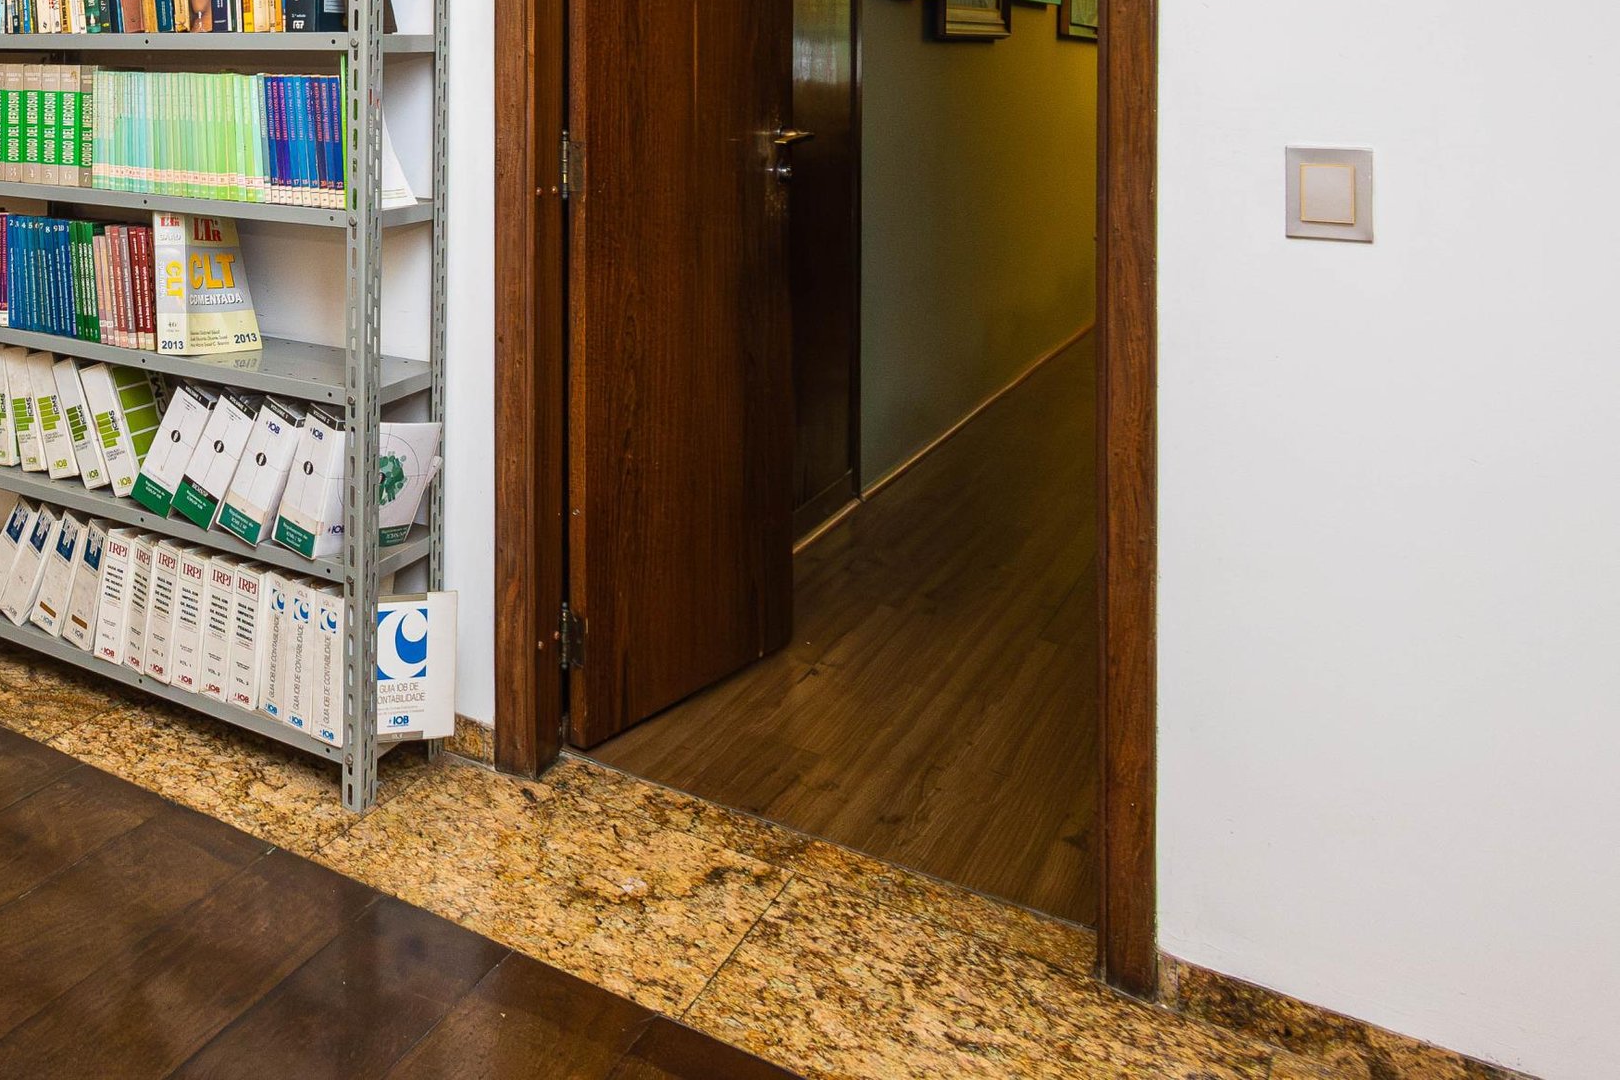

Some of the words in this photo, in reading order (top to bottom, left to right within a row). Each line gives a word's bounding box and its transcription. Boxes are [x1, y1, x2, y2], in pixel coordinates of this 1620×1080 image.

[8, 92, 19, 124] MERCOSUR
[27, 91, 38, 124] MERCOSUR
[44, 92, 55, 125] MERCOSUR
[63, 93, 74, 126] MERCOSUR
[82, 94, 92, 128] MERCOSUR
[8, 125, 19, 137] DEL
[27, 125, 38, 137] DEL
[44, 126, 55, 138] DEL
[63, 127, 74, 139] DEL
[82, 129, 92, 141] DEL
[46, 168, 53, 179] 5
[83, 172, 90, 182] 7
[188, 252, 236, 289] CLT
[166, 261, 184, 299] CLT
[189, 292, 244, 306] COMENTADA
[161, 340, 184, 350] 2013
[233, 333, 258, 344] 2013
[109, 410, 119, 431] ICMS
[268, 422, 280, 435] IOB
[312, 427, 323, 440] IOB
[109, 541, 128, 558] IRPJ
[136, 548, 151, 566] IRPJ
[159, 552, 176, 570] IRPJ
[182, 562, 202, 580] IRPJ
[212, 569, 231, 587] IRPJ
[238, 576, 257, 595] IRPJ
[270, 613, 279, 662] CONTABILIDADE
[104, 647, 115, 657] IOB
[294, 624, 304, 673] CONTABILIDADE
[131, 656, 140, 666] IOB
[323, 634, 331, 685] CONTABILIDADE
[153, 664, 164, 674] IOB
[270, 663, 276, 672] DE
[181, 675, 193, 685] IOB
[294, 674, 301, 683] DE
[208, 683, 221, 693] IOB
[323, 686, 330, 695] DE
[380, 684, 395, 693] GUIA
[397, 683, 408, 692] IOB
[409, 682, 419, 691] DE
[237, 693, 250, 703] IOB
[377, 692, 426, 705] ONTABILIDADE
[393, 715, 409, 725] IOB
